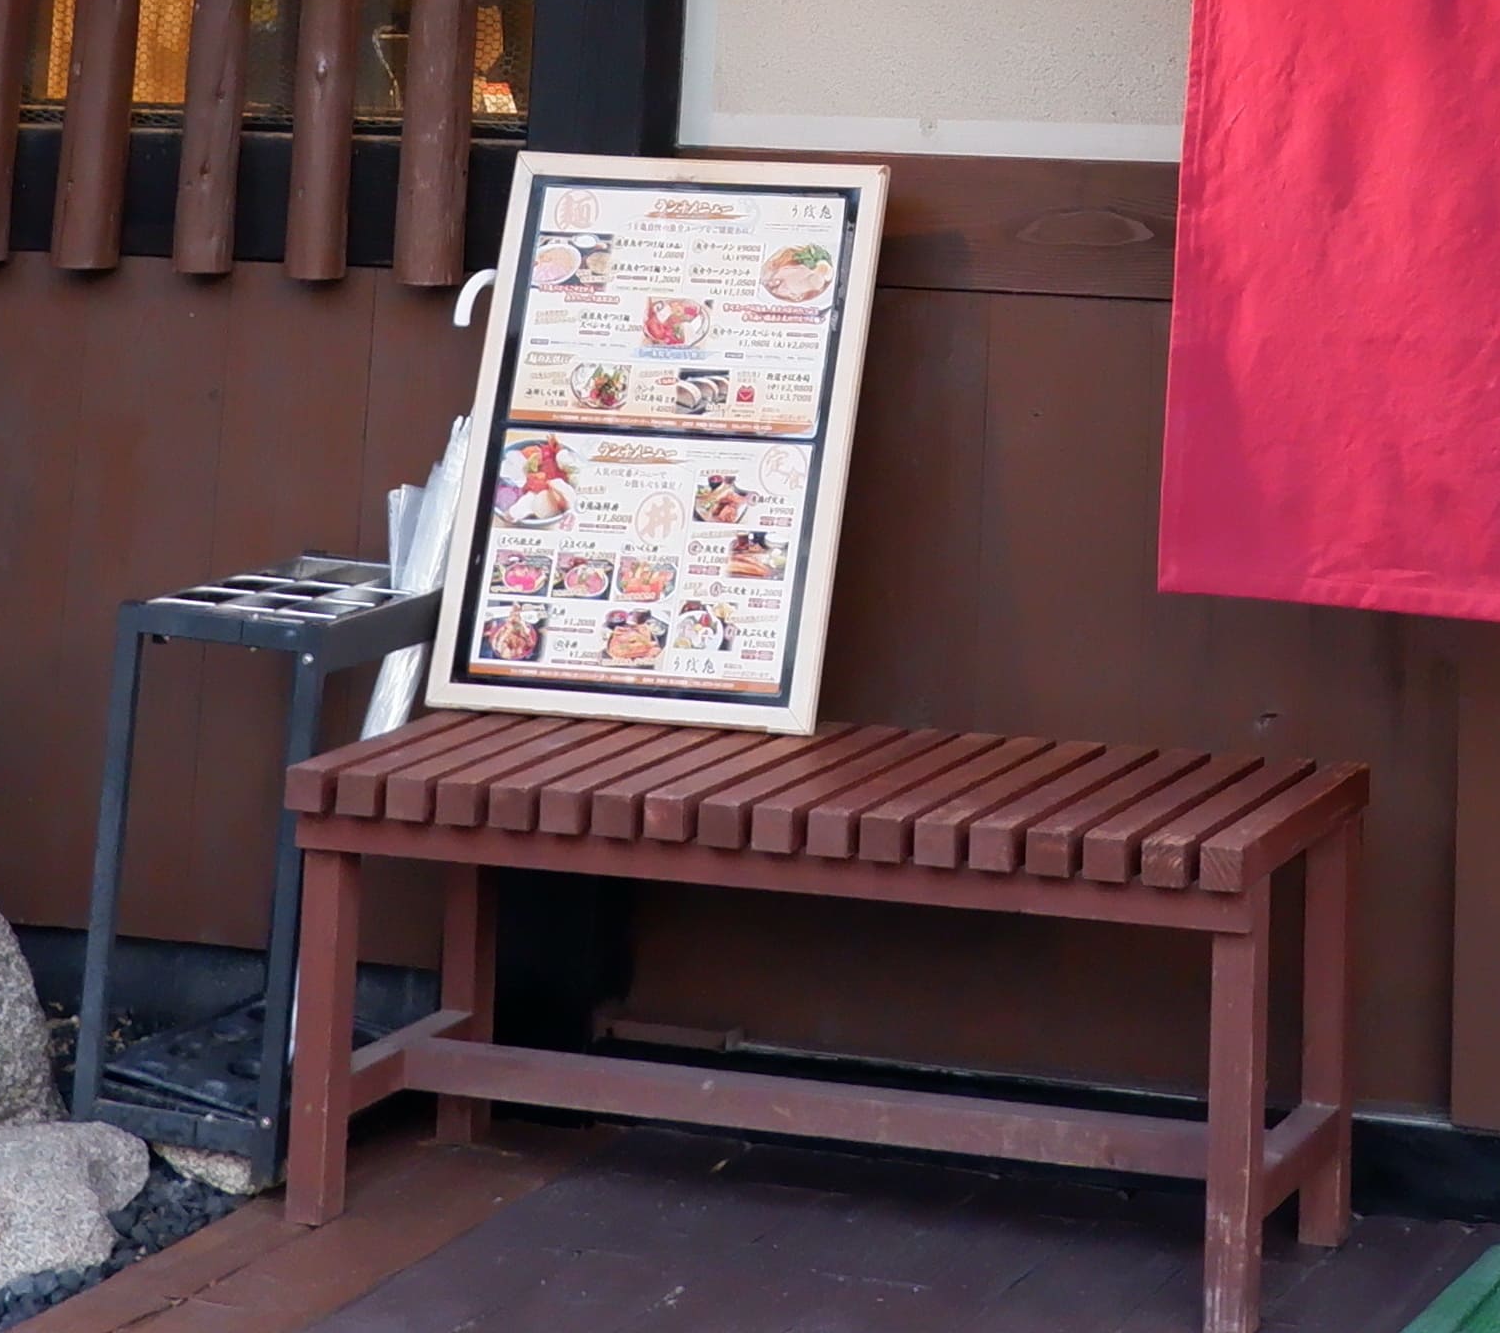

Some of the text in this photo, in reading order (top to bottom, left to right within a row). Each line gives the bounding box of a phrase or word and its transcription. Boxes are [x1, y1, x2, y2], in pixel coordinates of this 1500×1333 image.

[556, 191, 594, 231] 麺
[653, 198, 734, 213] ランチメニュー
[597, 441, 678, 457] ランチメニュー
